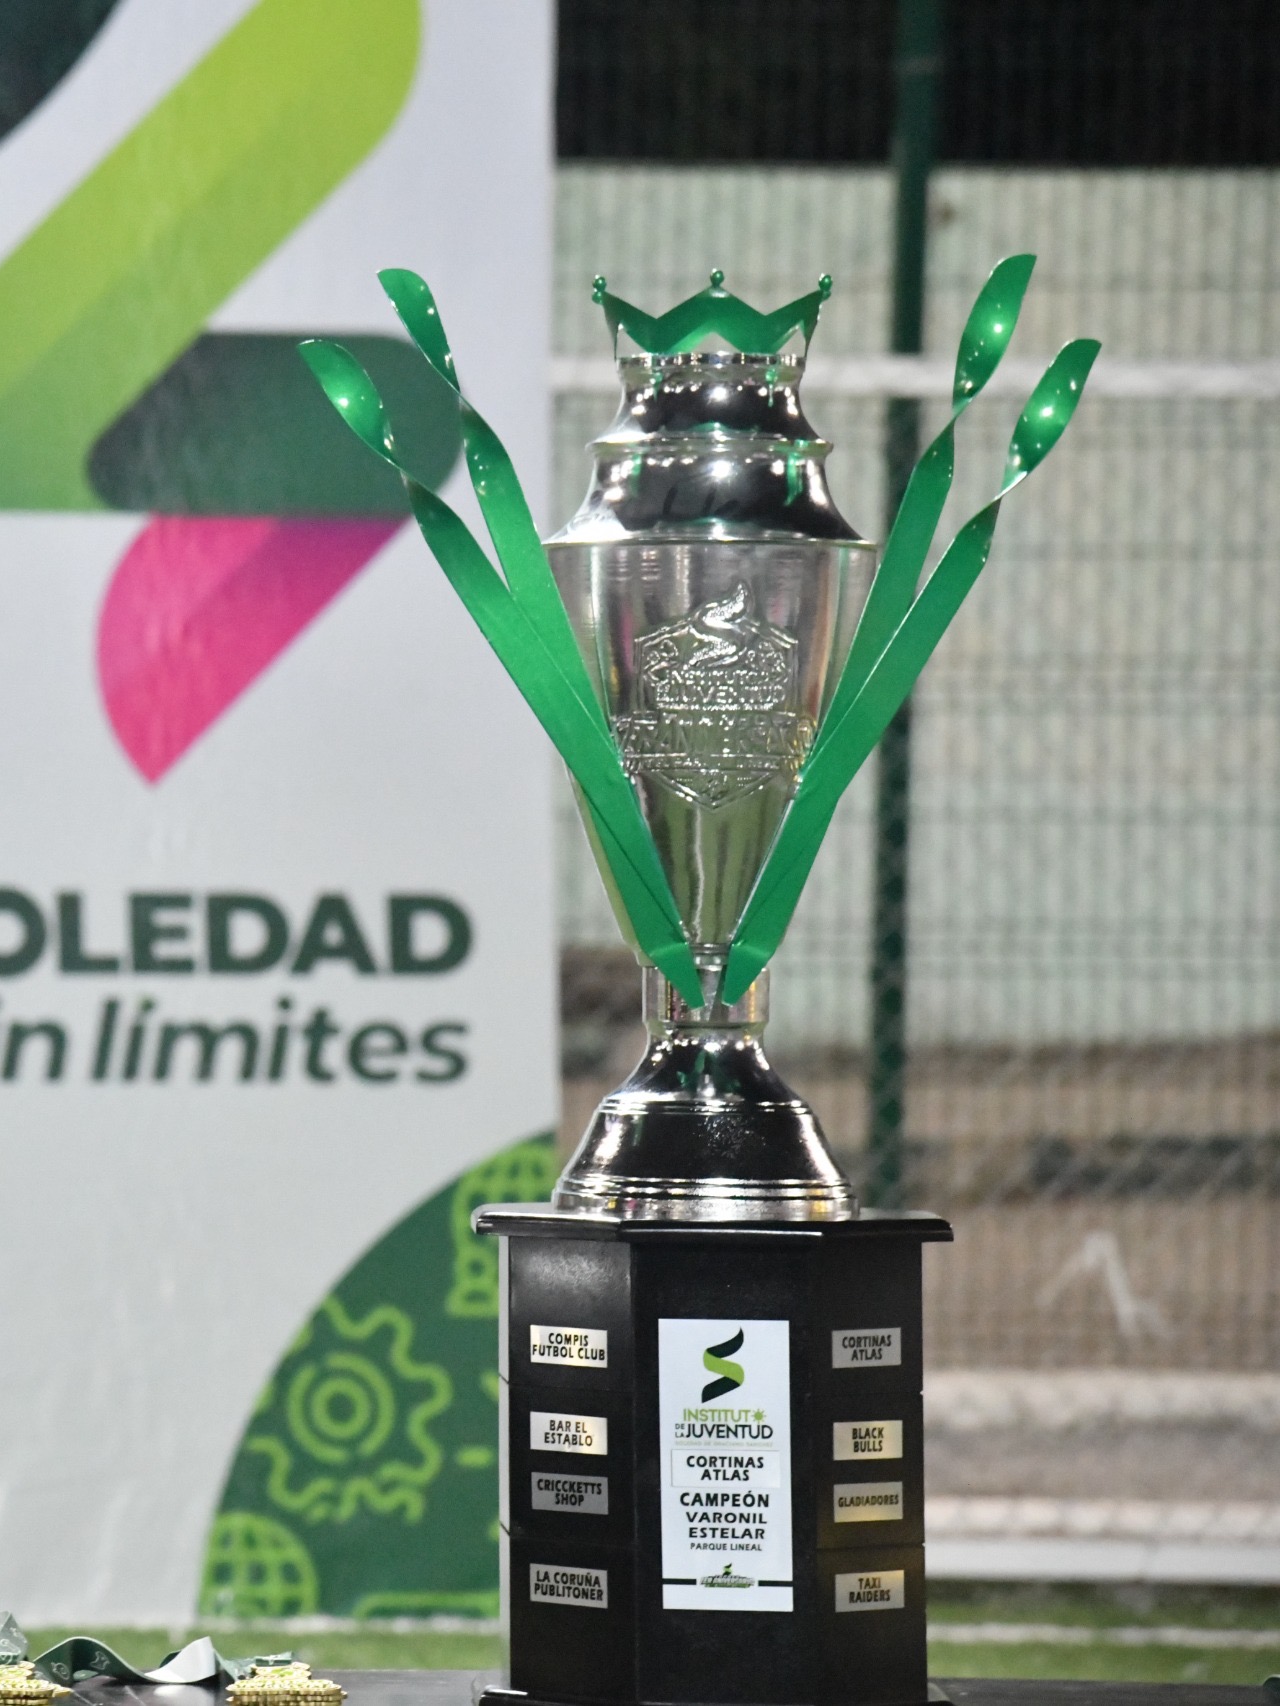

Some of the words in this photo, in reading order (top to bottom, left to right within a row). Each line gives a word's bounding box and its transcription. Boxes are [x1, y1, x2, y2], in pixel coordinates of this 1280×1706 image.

[91, 996, 469, 1083] límites
[548, 1332, 589, 1347] COMPIS
[842, 1335, 892, 1349] CORTINAS
[532, 1344, 574, 1358] FUTBOL
[577, 1347, 606, 1361] CLUB
[851, 1348, 883, 1361] ATLAS
[549, 1419, 572, 1433] BAR
[575, 1421, 588, 1434] EL
[686, 1423, 773, 1440] JUVENTUD
[852, 1427, 885, 1440] BLACK
[544, 1432, 594, 1447] ESTABLO
[853, 1440, 883, 1453] BULLS
[686, 1455, 765, 1469] CORTINAS
[700, 1469, 750, 1482] ATLAS
[537, 1478, 602, 1495] CRICCKETTS
[554, 1493, 585, 1506] SHOP
[680, 1490, 770, 1508] CAMPEÓN
[838, 1494, 900, 1508] GLADIADORES
[686, 1511, 768, 1525] VARONIL
[688, 1527, 765, 1540] ESTELAR
[690, 1542, 728, 1551] PARQUE
[730, 1543, 763, 1552] LINEAL
[536, 1570, 551, 1583] LA
[553, 1571, 602, 1588] CORUÑA
[858, 1577, 882, 1590] TAXI
[534, 1583, 604, 1602] PUBLITONER
[849, 1589, 891, 1604] RAIDERS
